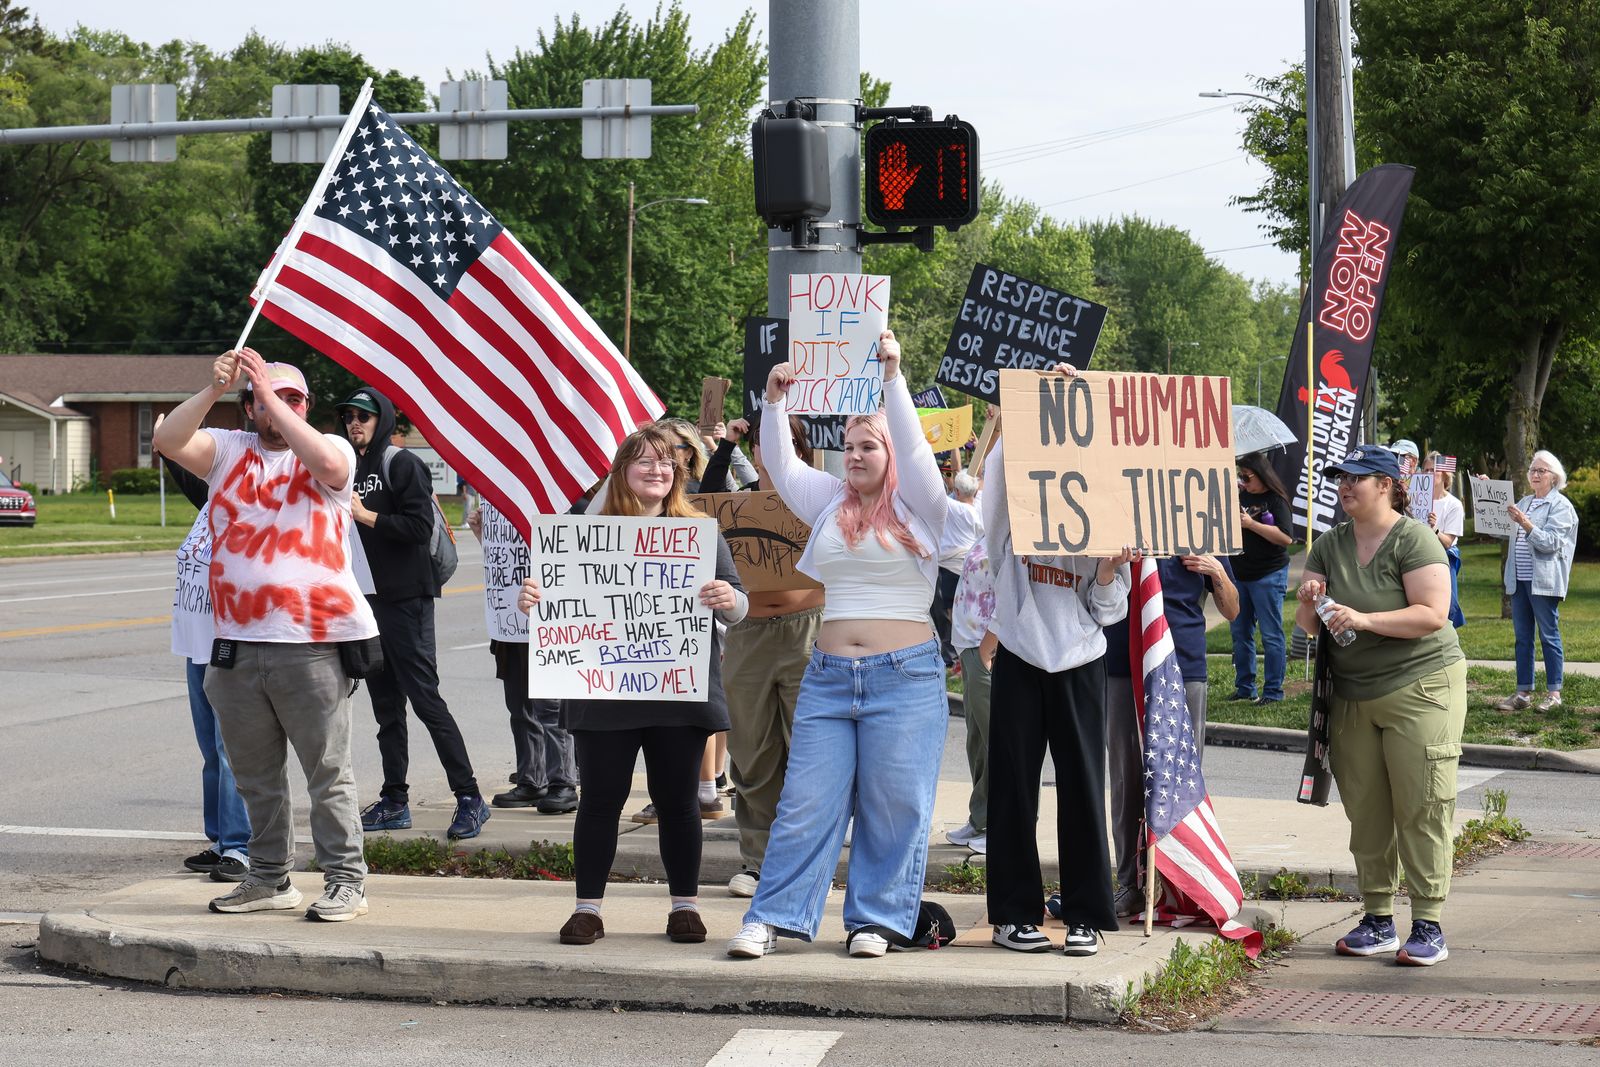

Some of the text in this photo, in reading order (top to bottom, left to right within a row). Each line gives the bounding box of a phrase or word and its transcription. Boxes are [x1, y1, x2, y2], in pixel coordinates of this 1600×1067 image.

[1320, 209, 1367, 331] NOW
[1346, 221, 1390, 340] OPEN
[789, 274, 885, 312] HONK
[980, 269, 1092, 327] RESPECT
[760, 322, 778, 355] IF
[815, 310, 860, 336] IF
[960, 298, 1077, 358] EXISTENCE
[793, 340, 880, 378] DJT'S A
[958, 332, 983, 357] OR
[937, 355, 999, 395] RESIS
[785, 377, 881, 414] DICKTATOR
[1315, 381, 1338, 411] TX
[1039, 375, 1229, 448] NO HUMAN
[1416, 475, 1430, 491] NO
[1028, 468, 1091, 553] IS
[538, 524, 700, 554] WE WILL NEVER
[177, 561, 201, 580] OFF
[509, 547, 531, 566] YEA
[492, 566, 530, 588] BREATH
[541, 561, 696, 589] BE TRULY FREE
[537, 591, 694, 621] UNTIL THOSE IN
[537, 616, 709, 648] BONDAGE HAVE THE
[536, 638, 698, 666] SAME RIGHTS AS
[577, 665, 698, 694] YOU AND ME!
